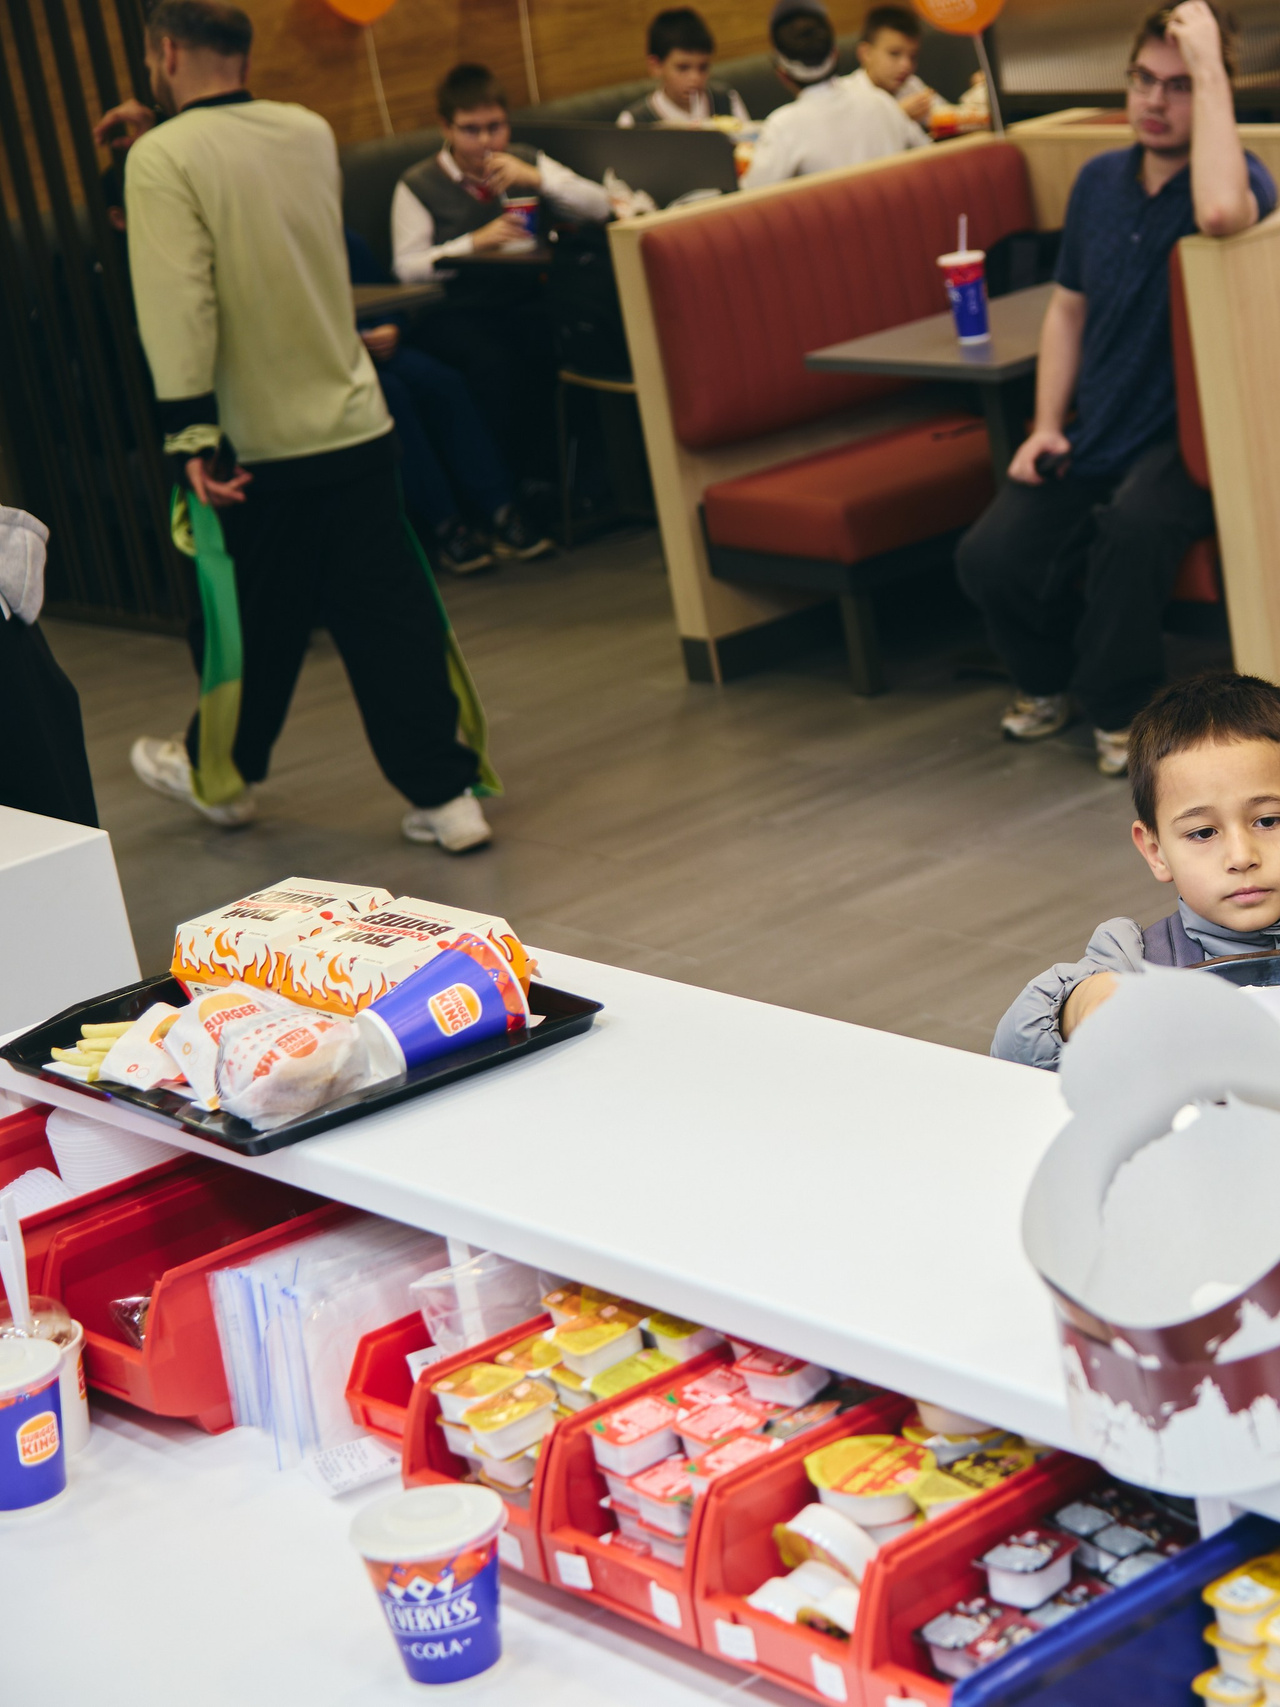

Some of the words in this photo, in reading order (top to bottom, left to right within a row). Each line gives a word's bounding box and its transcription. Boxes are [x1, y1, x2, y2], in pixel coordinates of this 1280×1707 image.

[249, 890, 338, 908] ВОППЕР
[221, 907, 289, 922] ТВОЙ
[360, 912, 455, 937] ВОППЕР
[333, 930, 405, 948] ТВОЙ
[203, 1003, 261, 1034] BURGER
[436, 993, 464, 1031] KING
[447, 988, 472, 1026] BURGER
[277, 1028, 309, 1049] KING
[22, 1432, 57, 1457] KING
[410, 1638, 465, 1660] COLA
